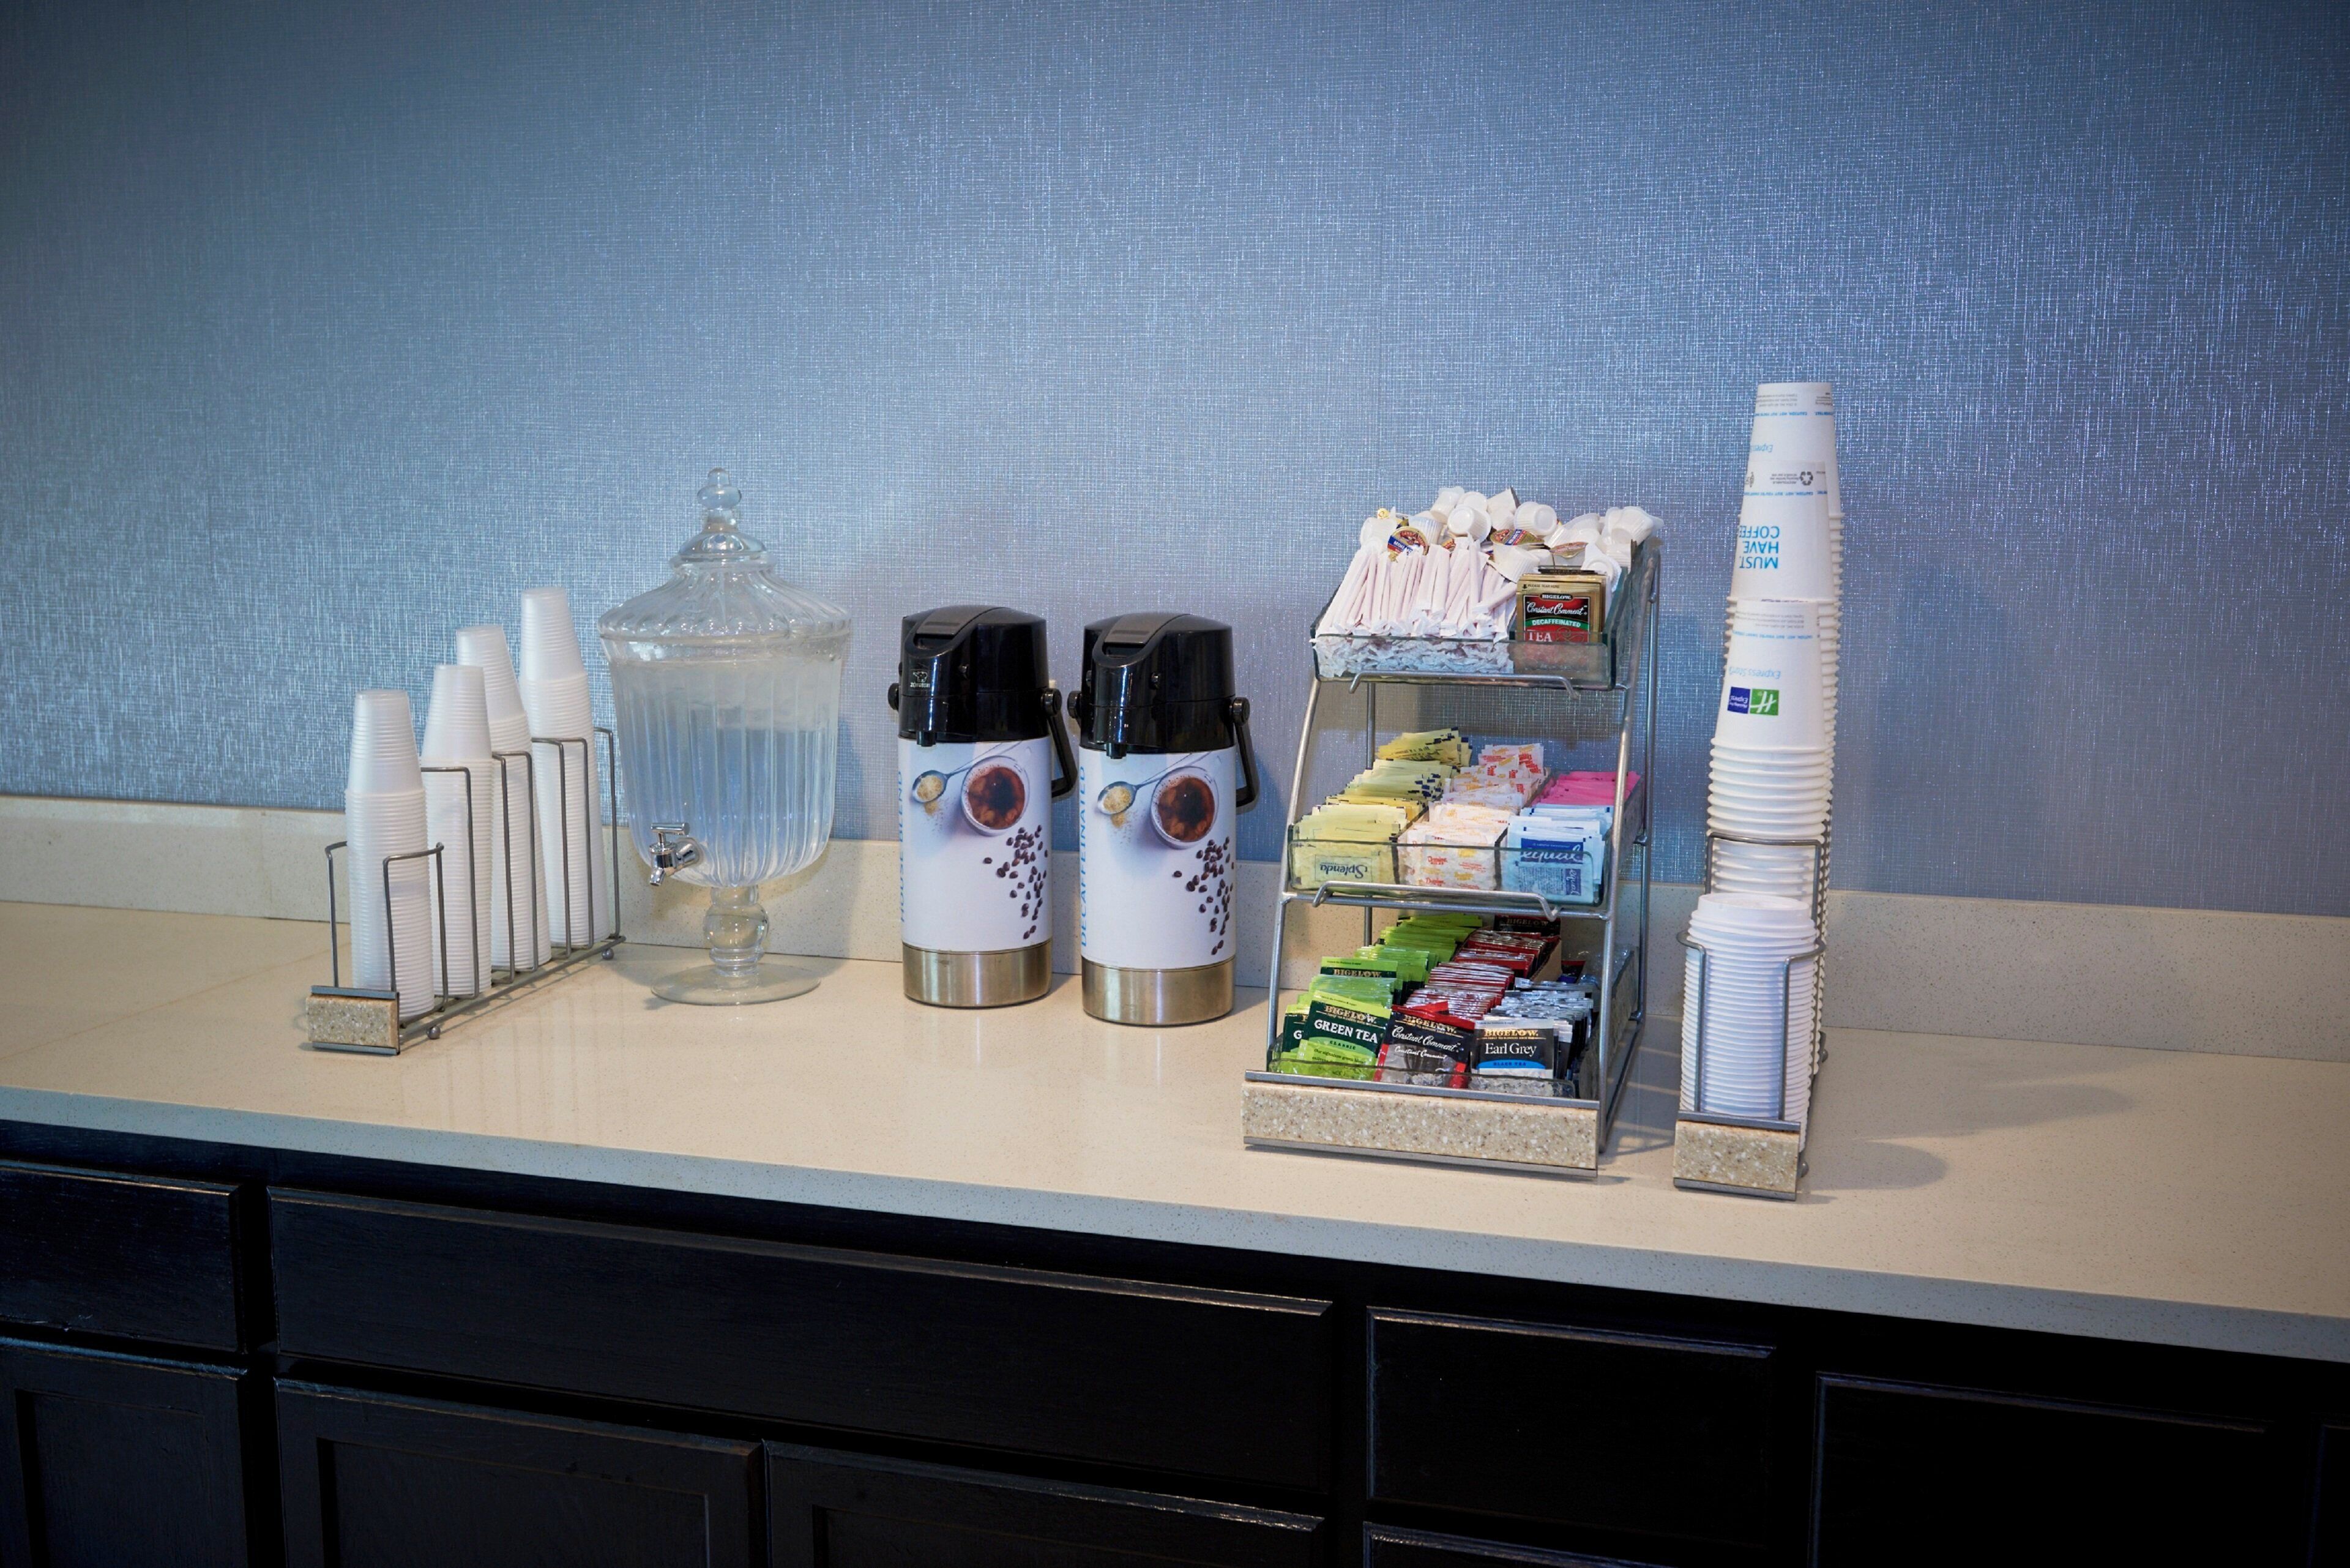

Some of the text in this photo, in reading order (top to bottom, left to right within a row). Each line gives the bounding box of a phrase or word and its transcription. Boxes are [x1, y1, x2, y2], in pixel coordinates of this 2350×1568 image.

[1739, 556, 1778, 569] MUST.
[1532, 619, 1581, 628] DECAFFEINATED
[1527, 629, 1553, 643] TEA
[1748, 669, 1781, 680] Express
[1521, 844, 1583, 863] equal
[1320, 864, 1368, 879] Splenda
[1314, 1019, 1354, 1038] GREEN
[1356, 1029, 1378, 1044] TEA
[1329, 1040, 1357, 1050] CLASSIC
[1485, 1042, 1537, 1058] Earl Grey
